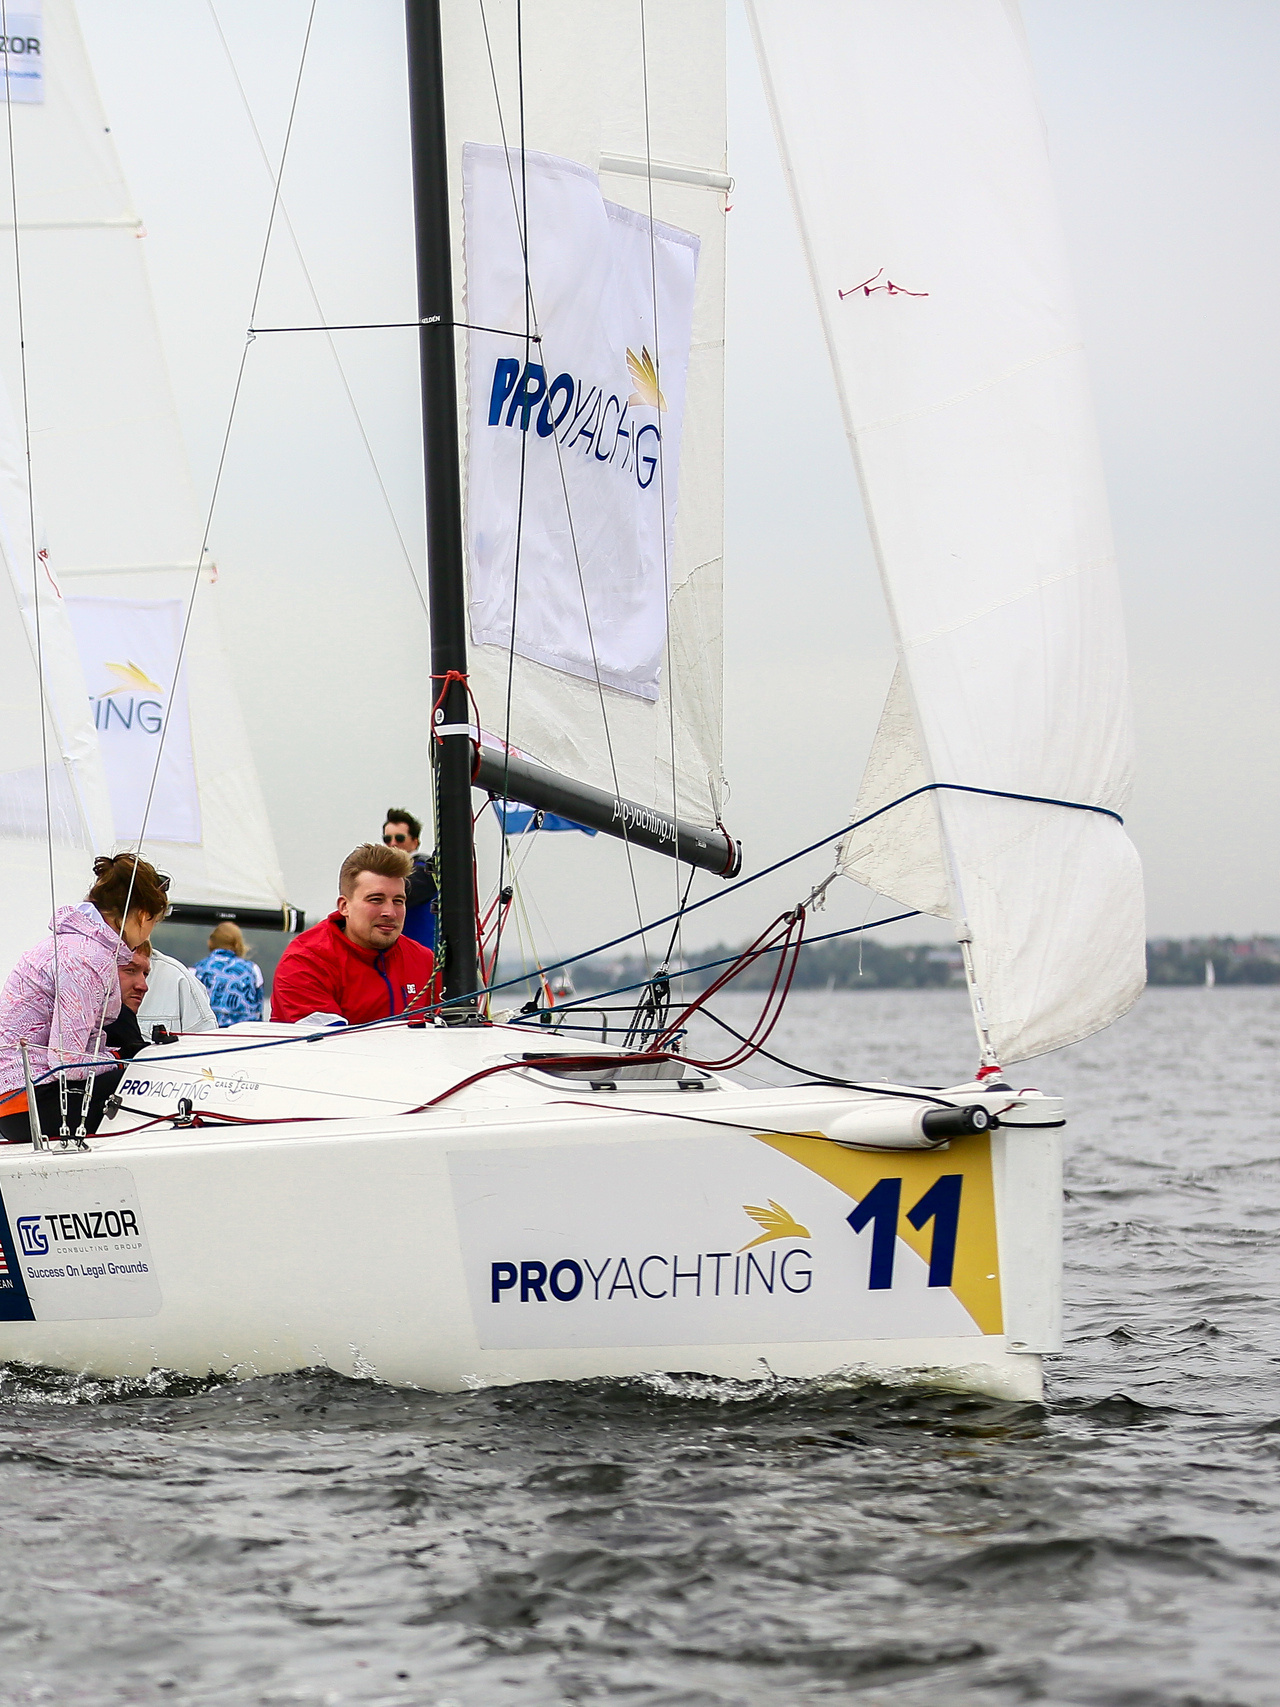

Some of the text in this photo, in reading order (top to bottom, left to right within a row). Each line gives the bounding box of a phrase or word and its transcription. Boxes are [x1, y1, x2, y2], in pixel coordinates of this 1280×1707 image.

[89, 696, 163, 734] ING
[119, 1080, 212, 1101] PROYACHTING
[44, 1209, 140, 1241] TENZOR
[846, 1174, 963, 1290] 11
[56, 1245, 109, 1254] CONSULTING
[27, 1261, 149, 1279] Success On Legal Grounds
[491, 1249, 813, 1303] PROYACHTING
